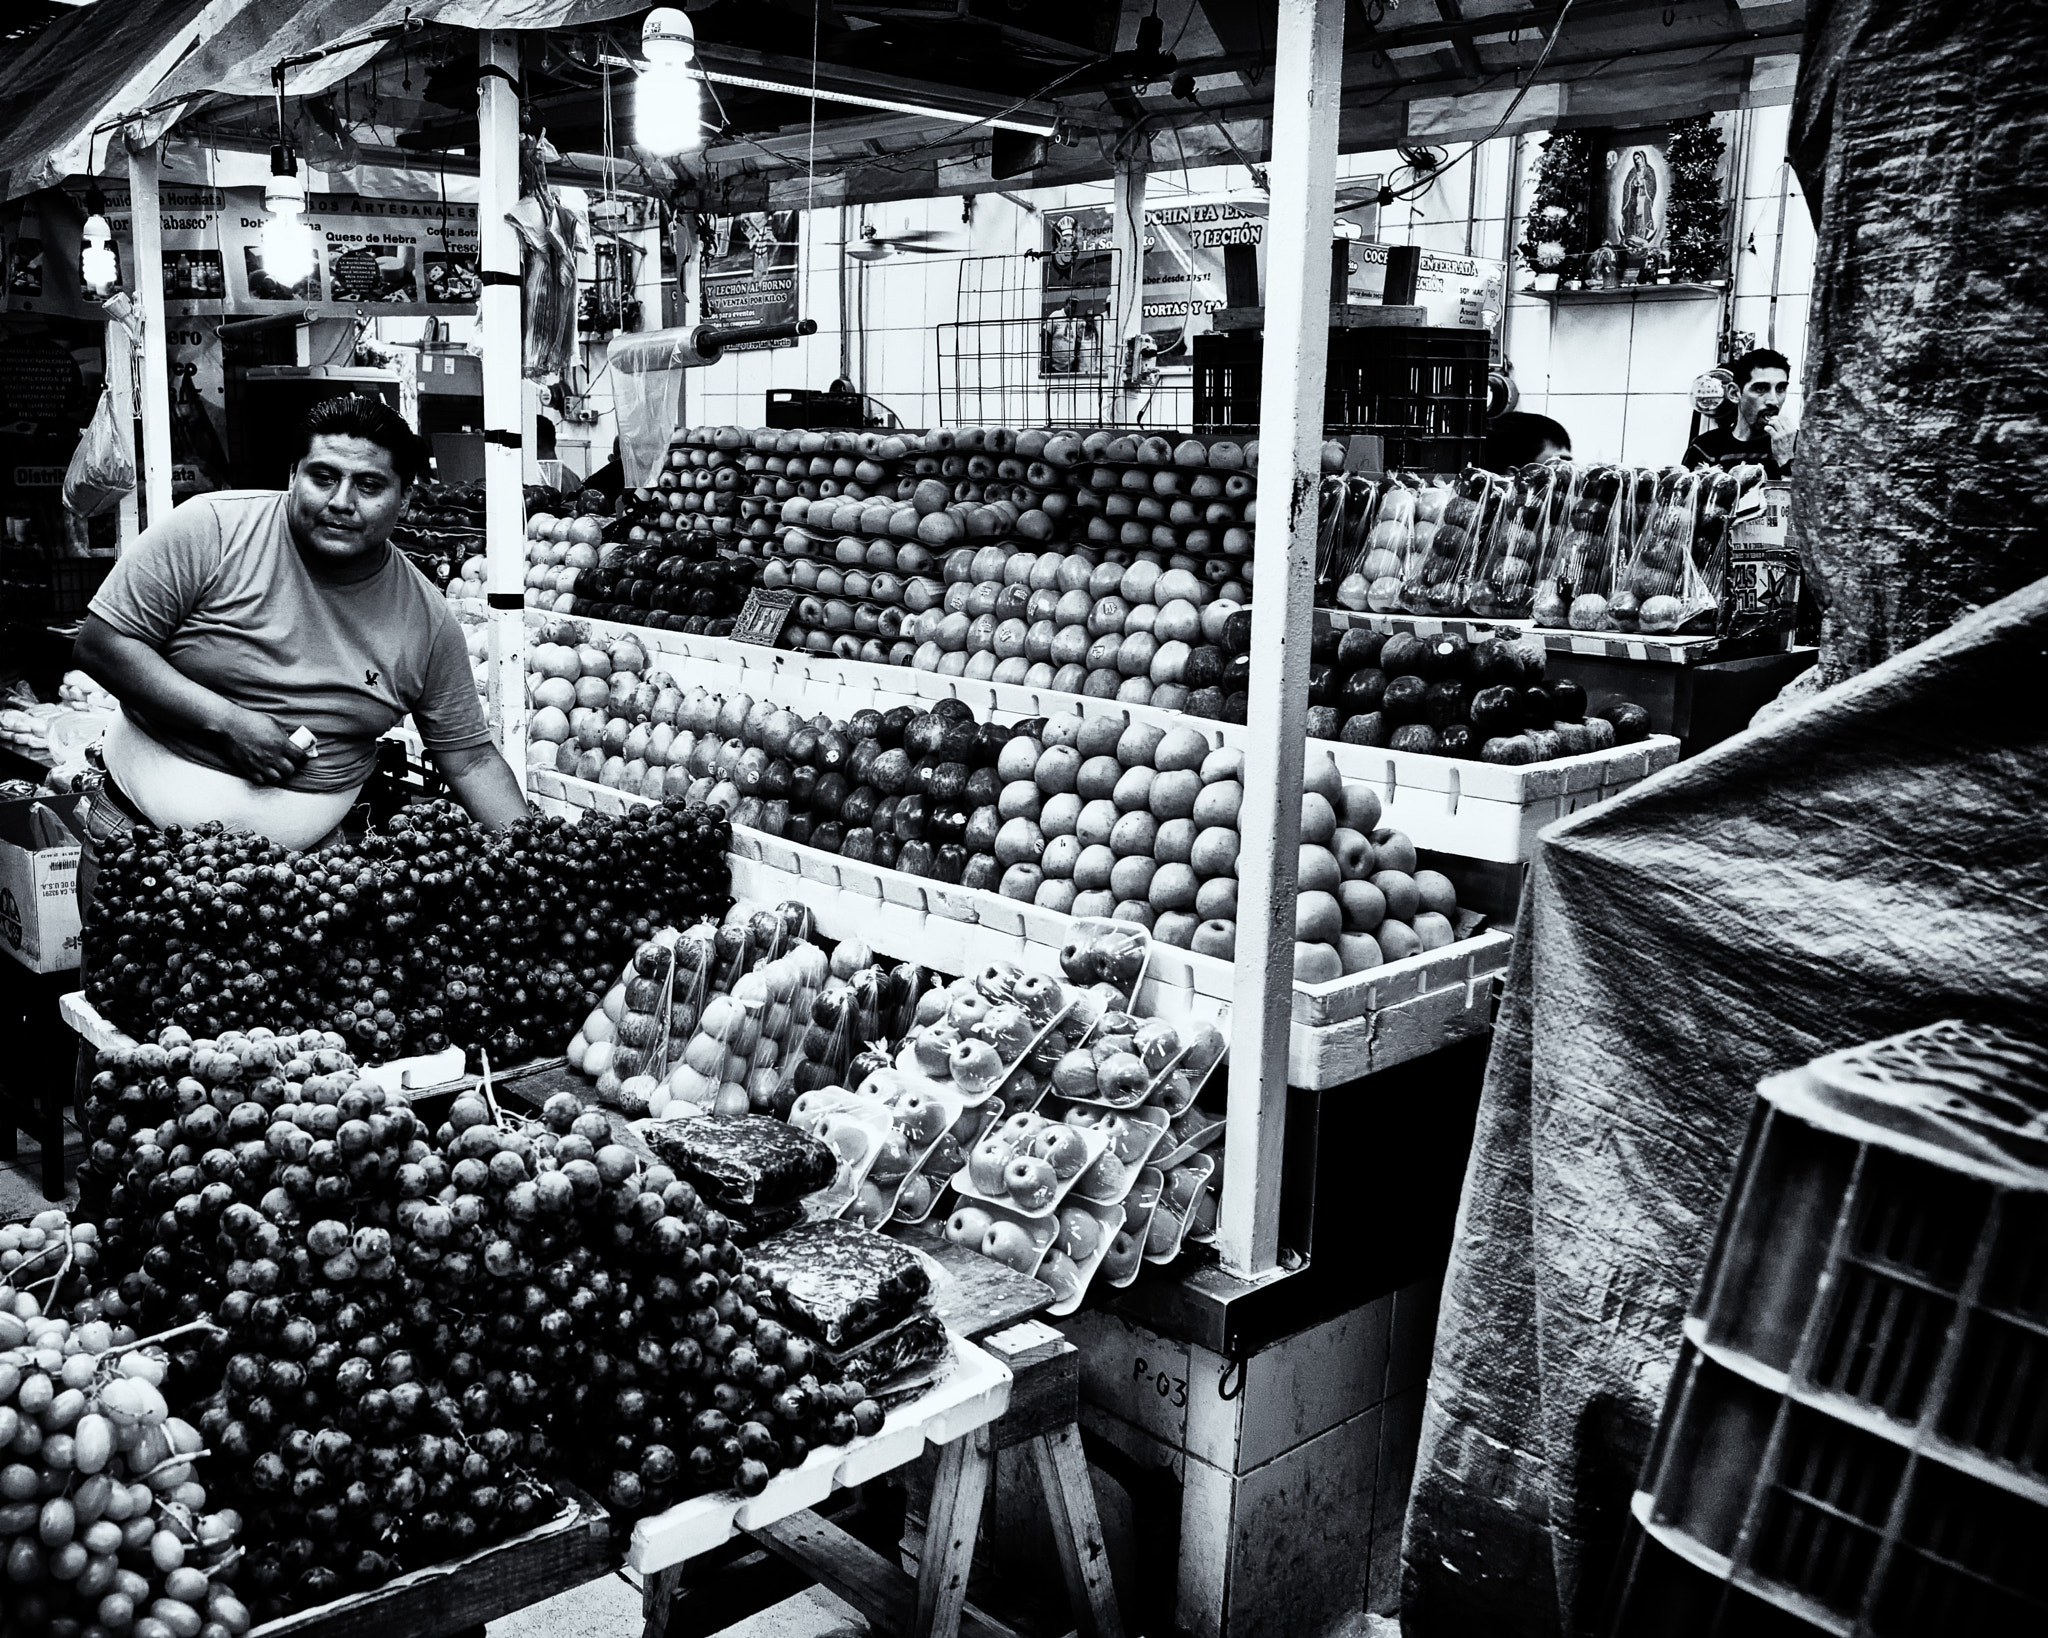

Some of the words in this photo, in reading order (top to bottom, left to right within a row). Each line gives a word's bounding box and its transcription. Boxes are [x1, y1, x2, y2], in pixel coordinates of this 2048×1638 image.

[169, 191, 222, 206] Horchata
[351, 200, 476, 218] ARTESANALES
[1144, 205, 1218, 227] OCHINITA
[326, 231, 362, 242] Queso
[366, 232, 380, 242] de
[383, 234, 417, 244] Hebra
[1204, 222, 1262, 248] LECHÓN
[1082, 239, 1096, 250] La
[1420, 255, 1479, 277] ENTERRADA
[1162, 273, 1185, 283] desde
[1416, 273, 1444, 293] ECHÓN
[707, 287, 714, 296] Y
[716, 280, 747, 296] LECHÓN
[749, 282, 760, 293] AL
[762, 279, 792, 291] HORNO
[722, 297, 748, 308] VENTAS
[750, 295, 762, 305] POR
[764, 293, 788, 304] KILOS
[732, 309, 755, 318] eventos
[1143, 302, 1188, 317] TORTAS
[1192, 301, 1202, 315] Y
[1133, 1357, 1187, 1408] P-03
